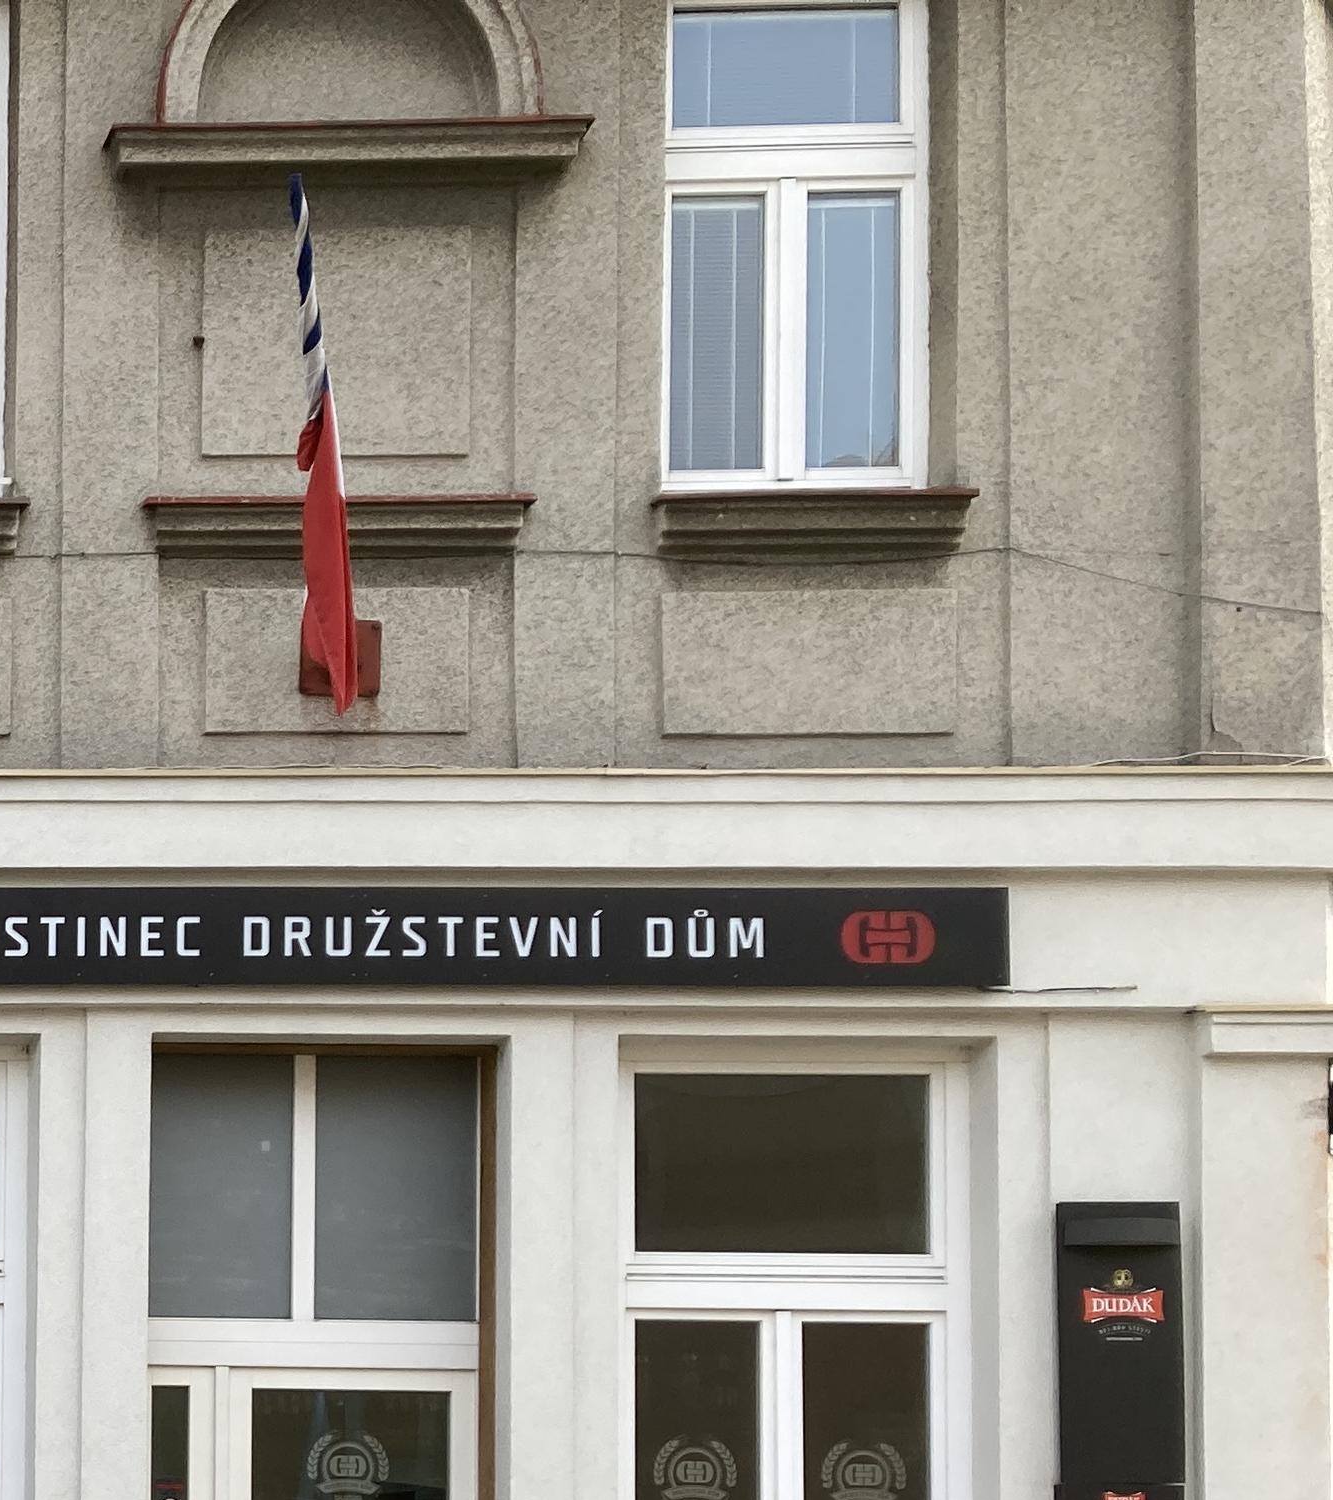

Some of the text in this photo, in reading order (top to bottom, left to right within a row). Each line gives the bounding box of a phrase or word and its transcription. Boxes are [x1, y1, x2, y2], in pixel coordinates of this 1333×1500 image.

[244, 908, 603, 958] DRUŽSTEVNÍ
[646, 908, 765, 958] DŮM
[1092, 1295, 1156, 1313] DUDÁK
